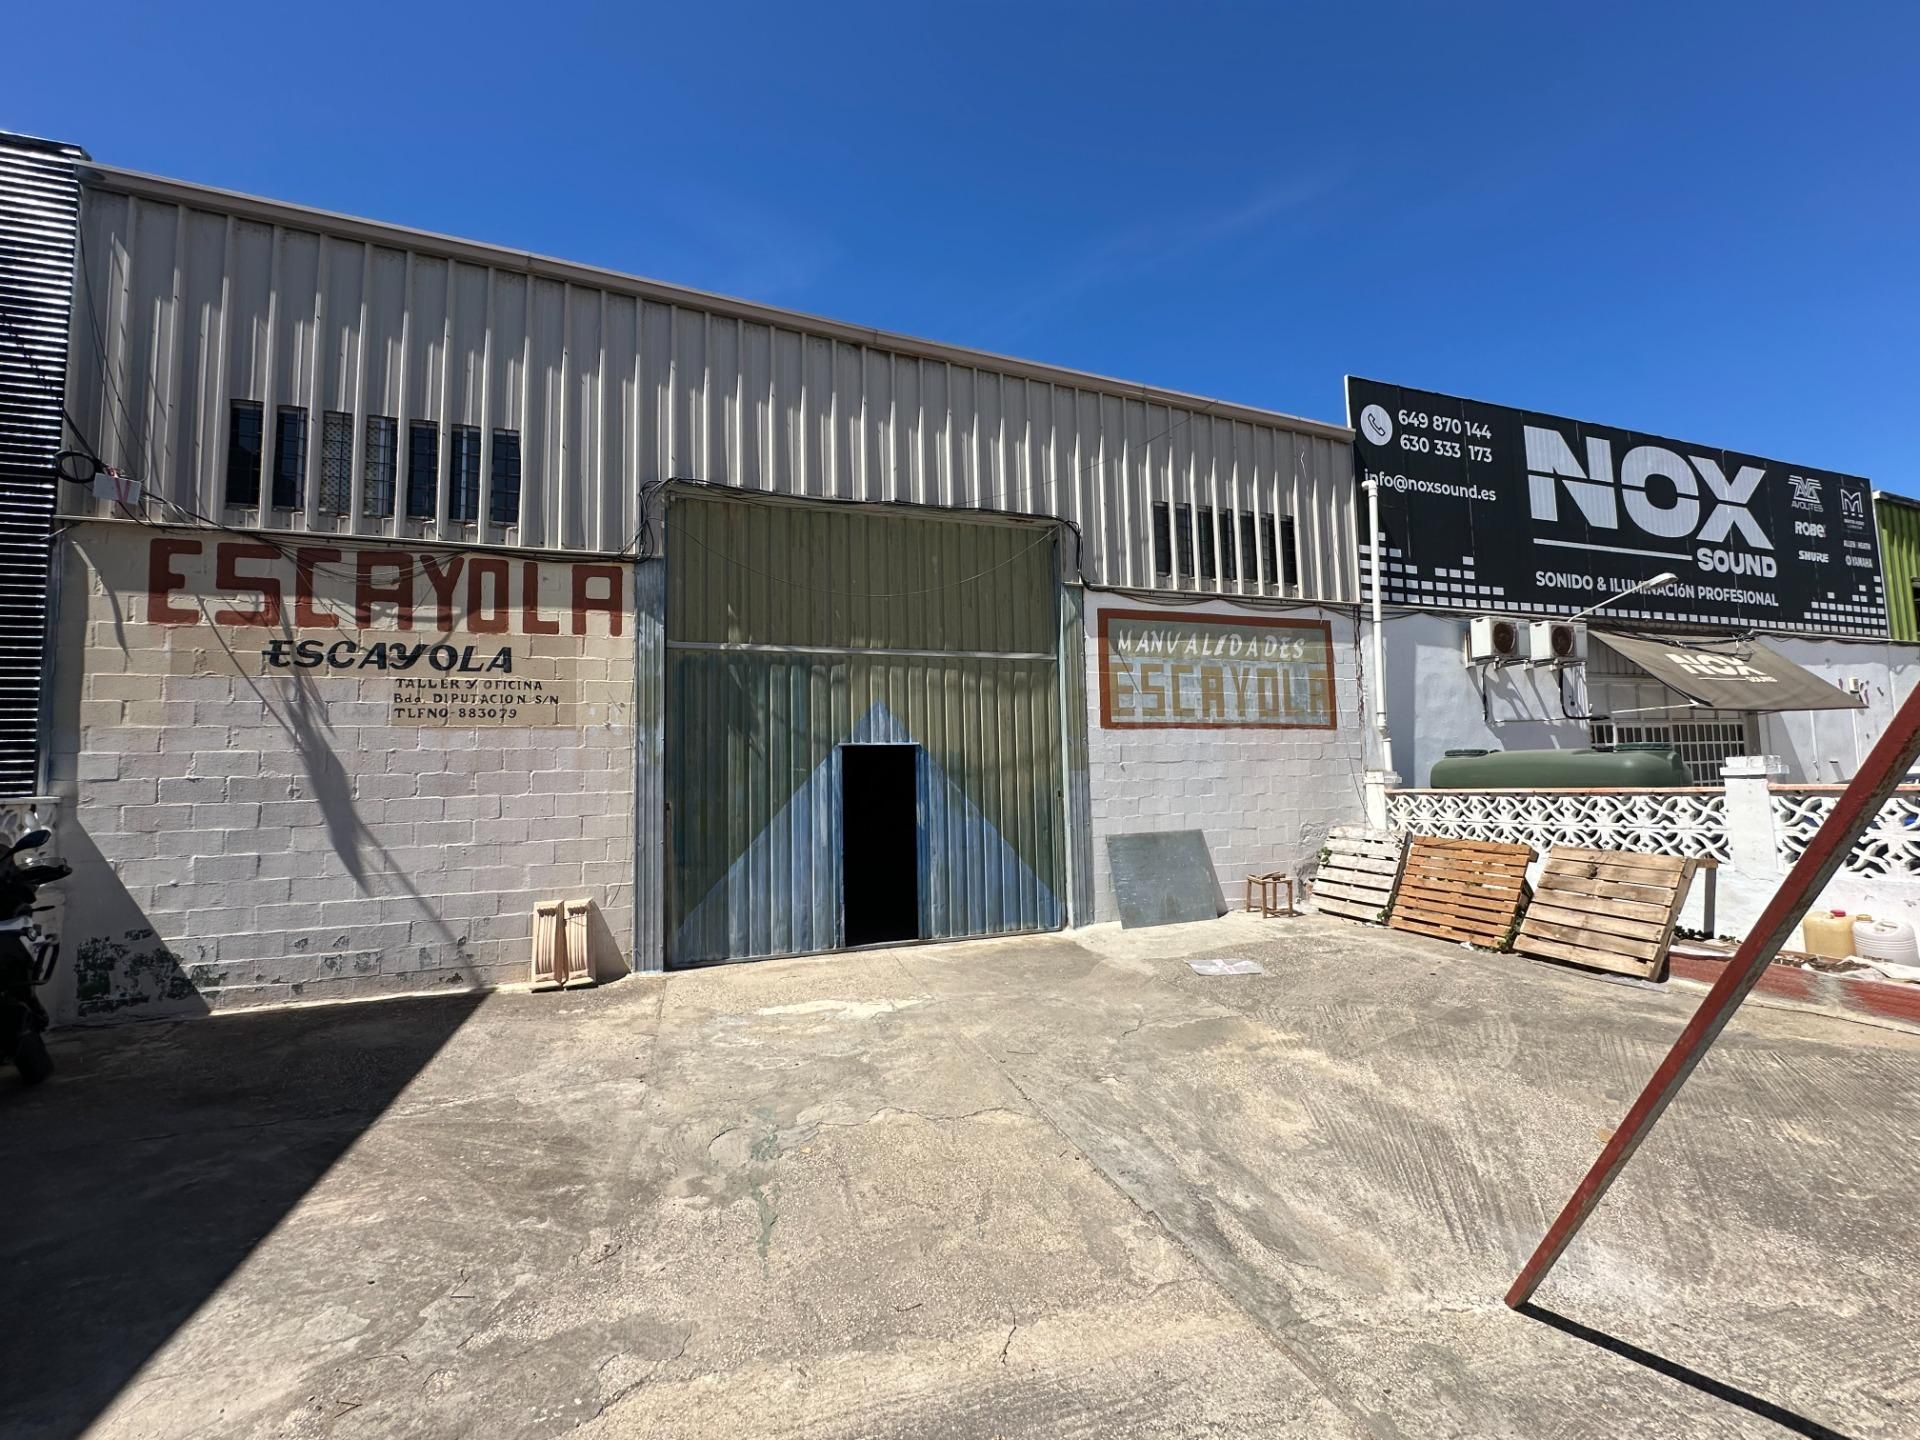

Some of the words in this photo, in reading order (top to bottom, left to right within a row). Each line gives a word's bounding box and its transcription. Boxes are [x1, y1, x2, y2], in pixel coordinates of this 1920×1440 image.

[1398, 409, 1429, 429] 649
[1432, 415, 1462, 435] 870
[1464, 420, 1492, 440] 144
[1400, 434, 1430, 453] 630
[1433, 439, 1461, 458] 333
[1468, 445, 1493, 463] 173
[1364, 468, 1497, 501] info@noxsound.es
[1523, 425, 1775, 550] NOX
[1696, 547, 1778, 579] SOUND
[1798, 550, 1830, 563] SHURE
[147, 538, 624, 637] ESCAYOLA
[1535, 571, 1593, 591] SONIDO
[1597, 576, 1607, 592] &
[1698, 586, 1779, 607] PROFESIONAL
[262, 639, 512, 674] ESCAYOLA
[395, 678, 461, 690] TALLER
[483, 679, 543, 691] OFICINA
[433, 693, 527, 705] DIPUTACION
[534, 694, 560, 705] S/N
[1110, 663, 1330, 718] ESCAYOLA
